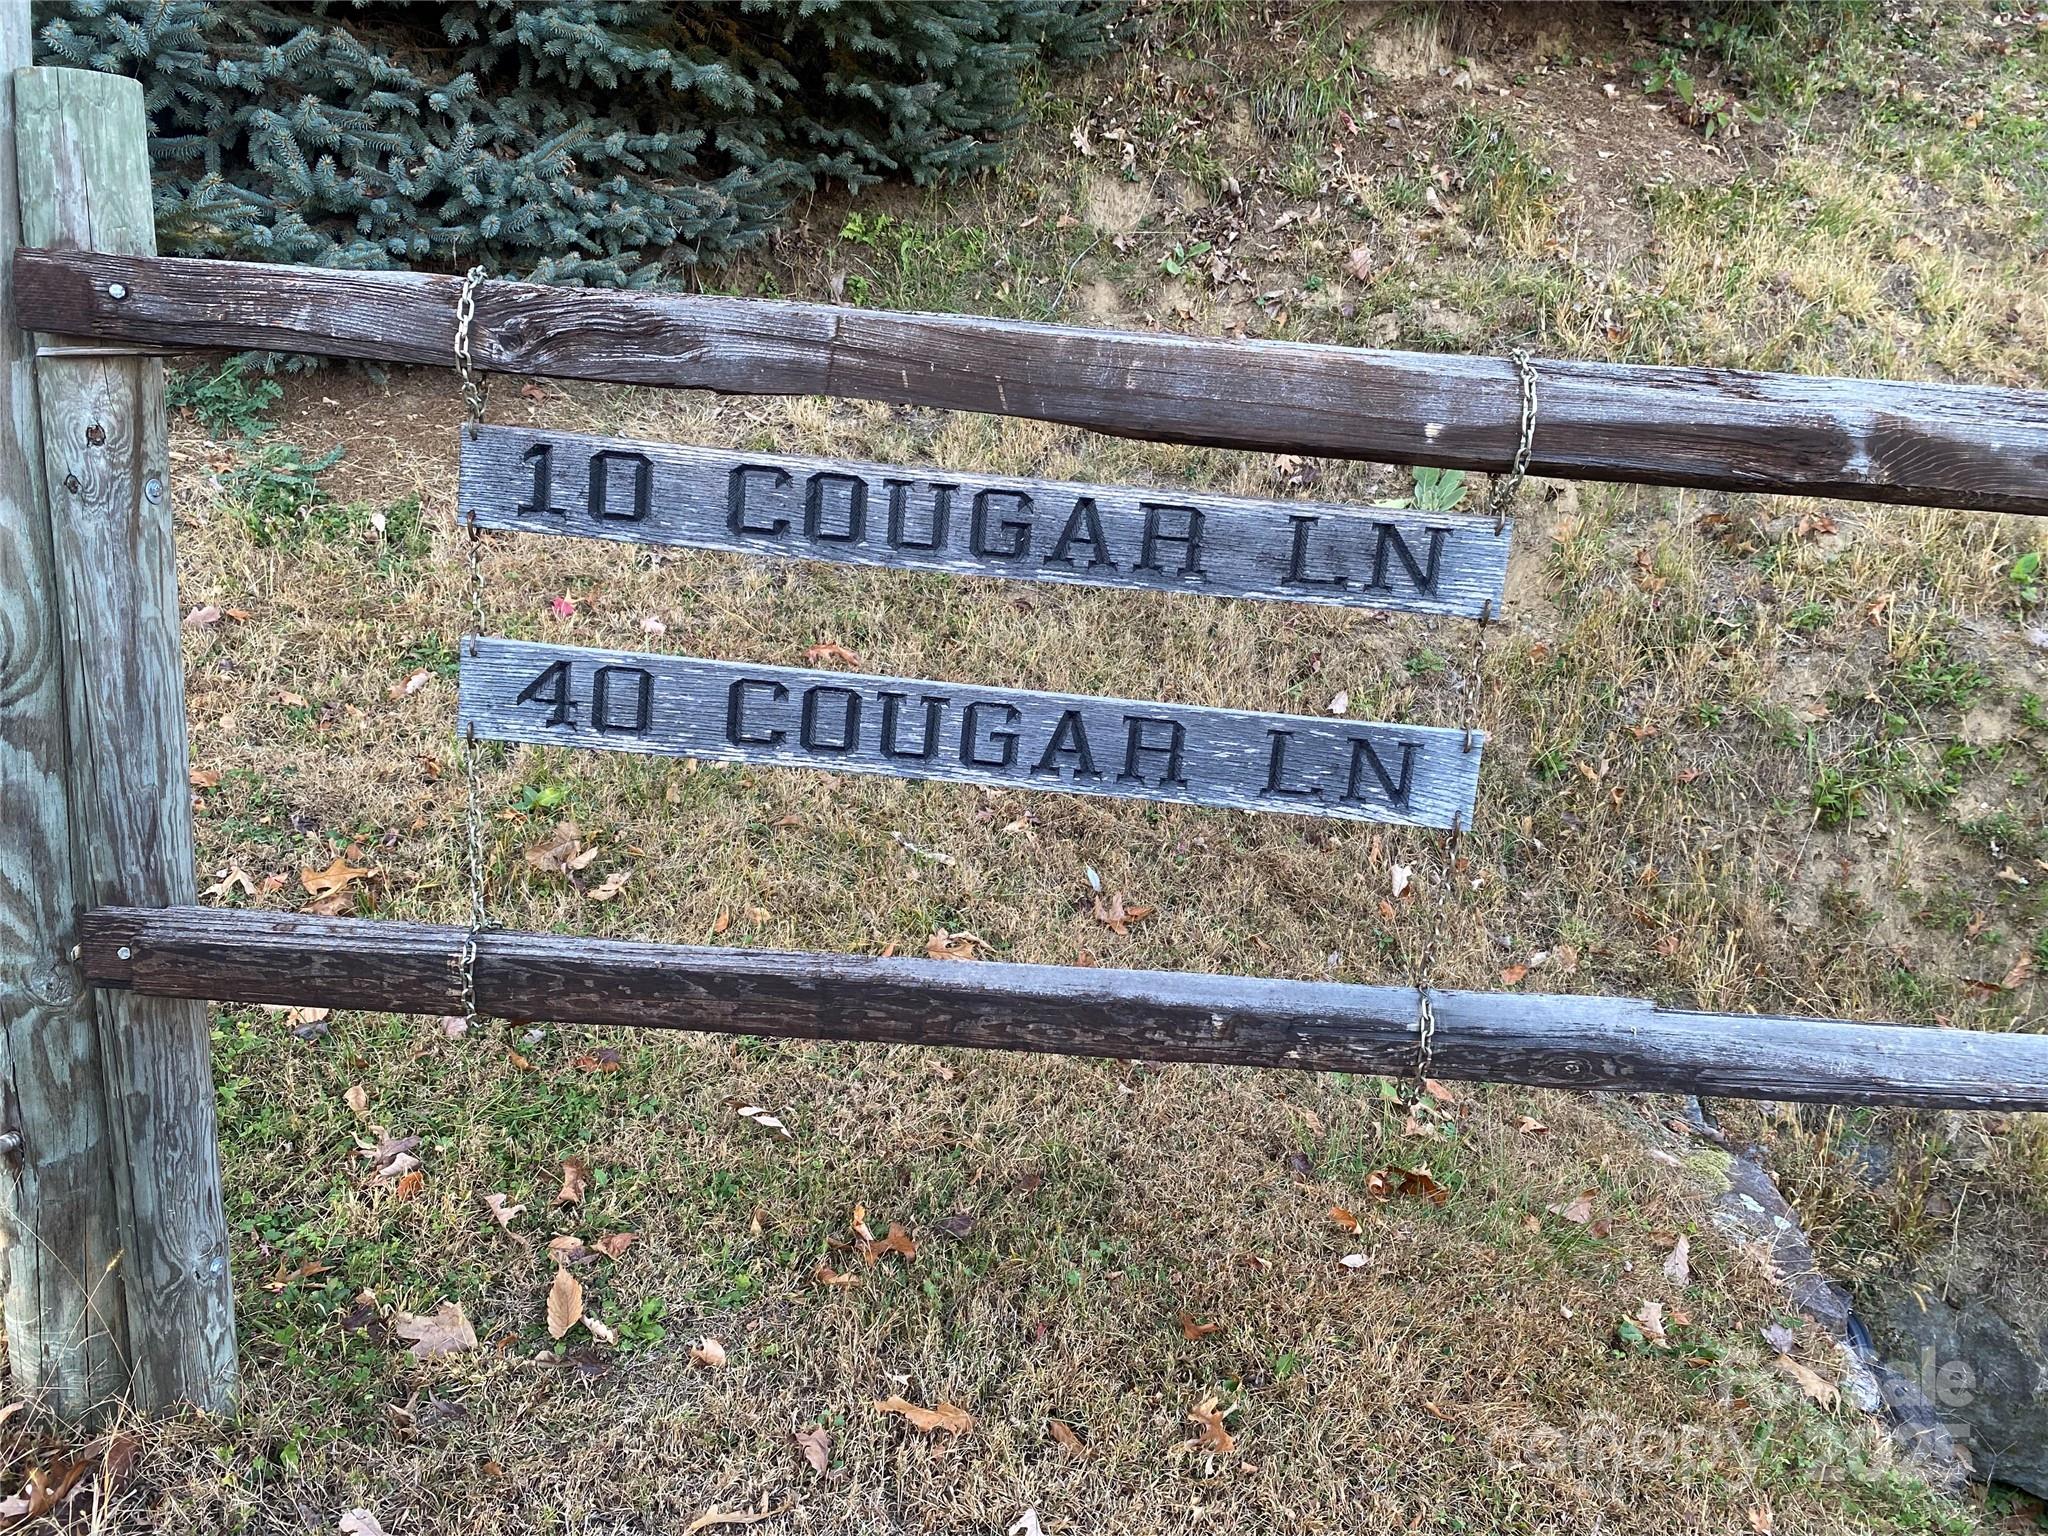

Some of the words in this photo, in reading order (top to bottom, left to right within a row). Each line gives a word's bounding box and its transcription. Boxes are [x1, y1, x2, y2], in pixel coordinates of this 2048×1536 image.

[517, 442, 654, 523] 10
[725, 463, 1207, 579] COUGAR
[1280, 515, 1454, 597] LN
[516, 659, 655, 739] 40
[725, 677, 1188, 790] COUGAR
[1259, 729, 1425, 810] LN
